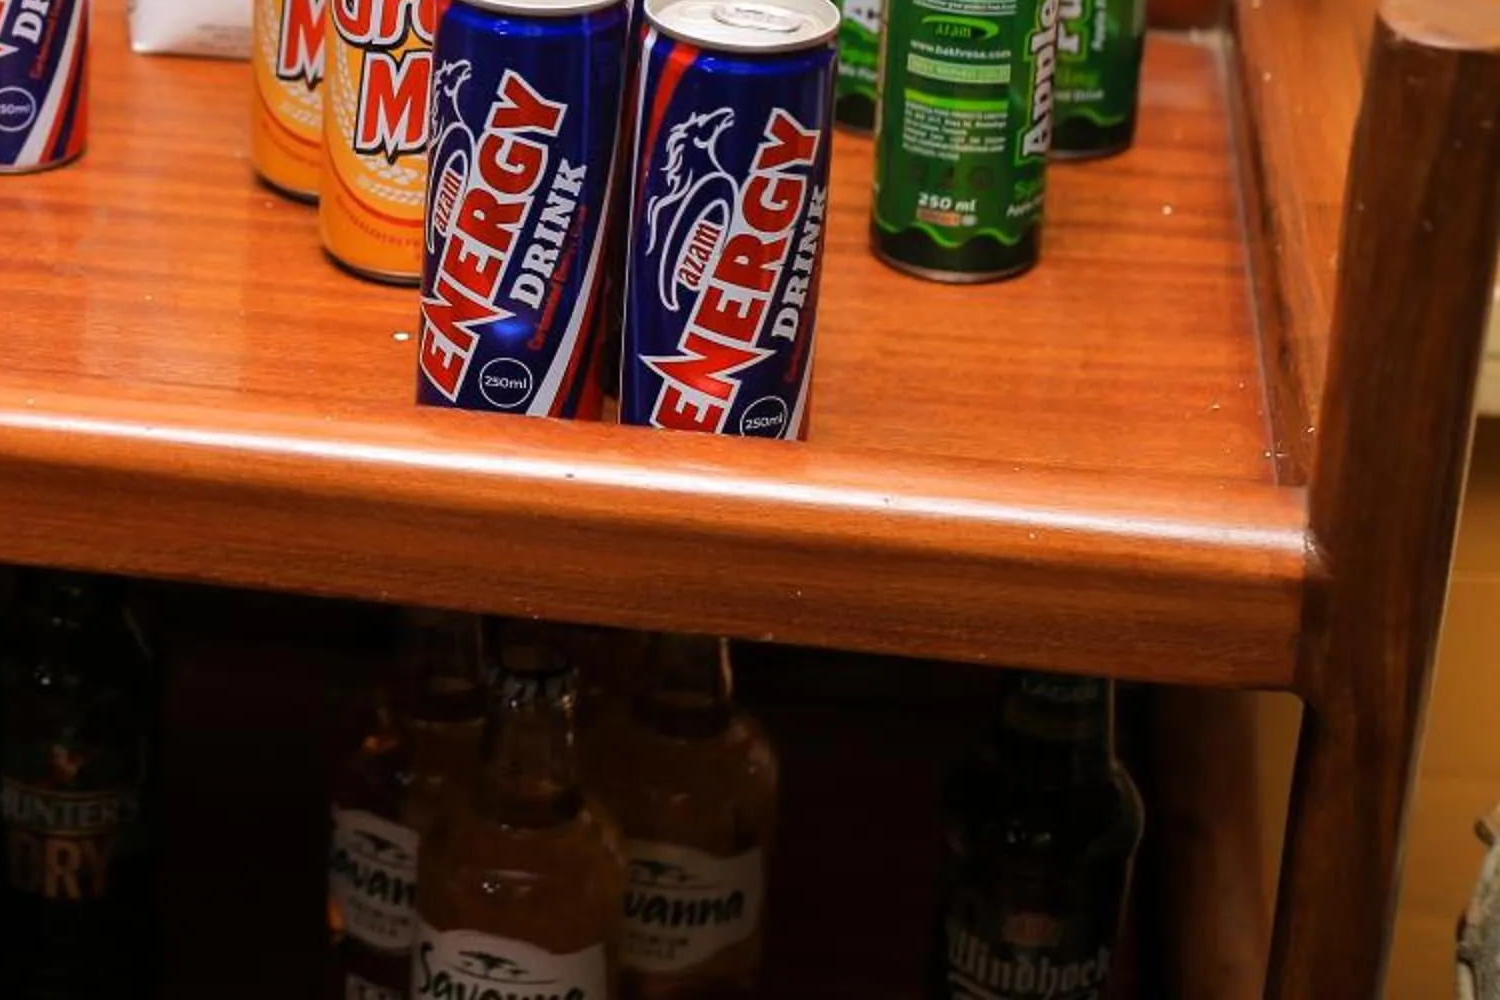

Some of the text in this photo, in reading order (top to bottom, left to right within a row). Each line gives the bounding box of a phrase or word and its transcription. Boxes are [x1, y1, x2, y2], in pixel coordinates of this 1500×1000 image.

[418, 68, 569, 403] ENERGY
[510, 157, 587, 311] DRINK
[917, 191, 978, 213] 250 ml
[639, 107, 821, 435] ENERGY
[677, 222, 721, 292] azam
[771, 186, 828, 343] DRINK
[483, 373, 528, 392] 250ml
[744, 407, 784, 431] 250ml
[6, 828, 119, 899] DRY
[622, 889, 745, 927] vanna
